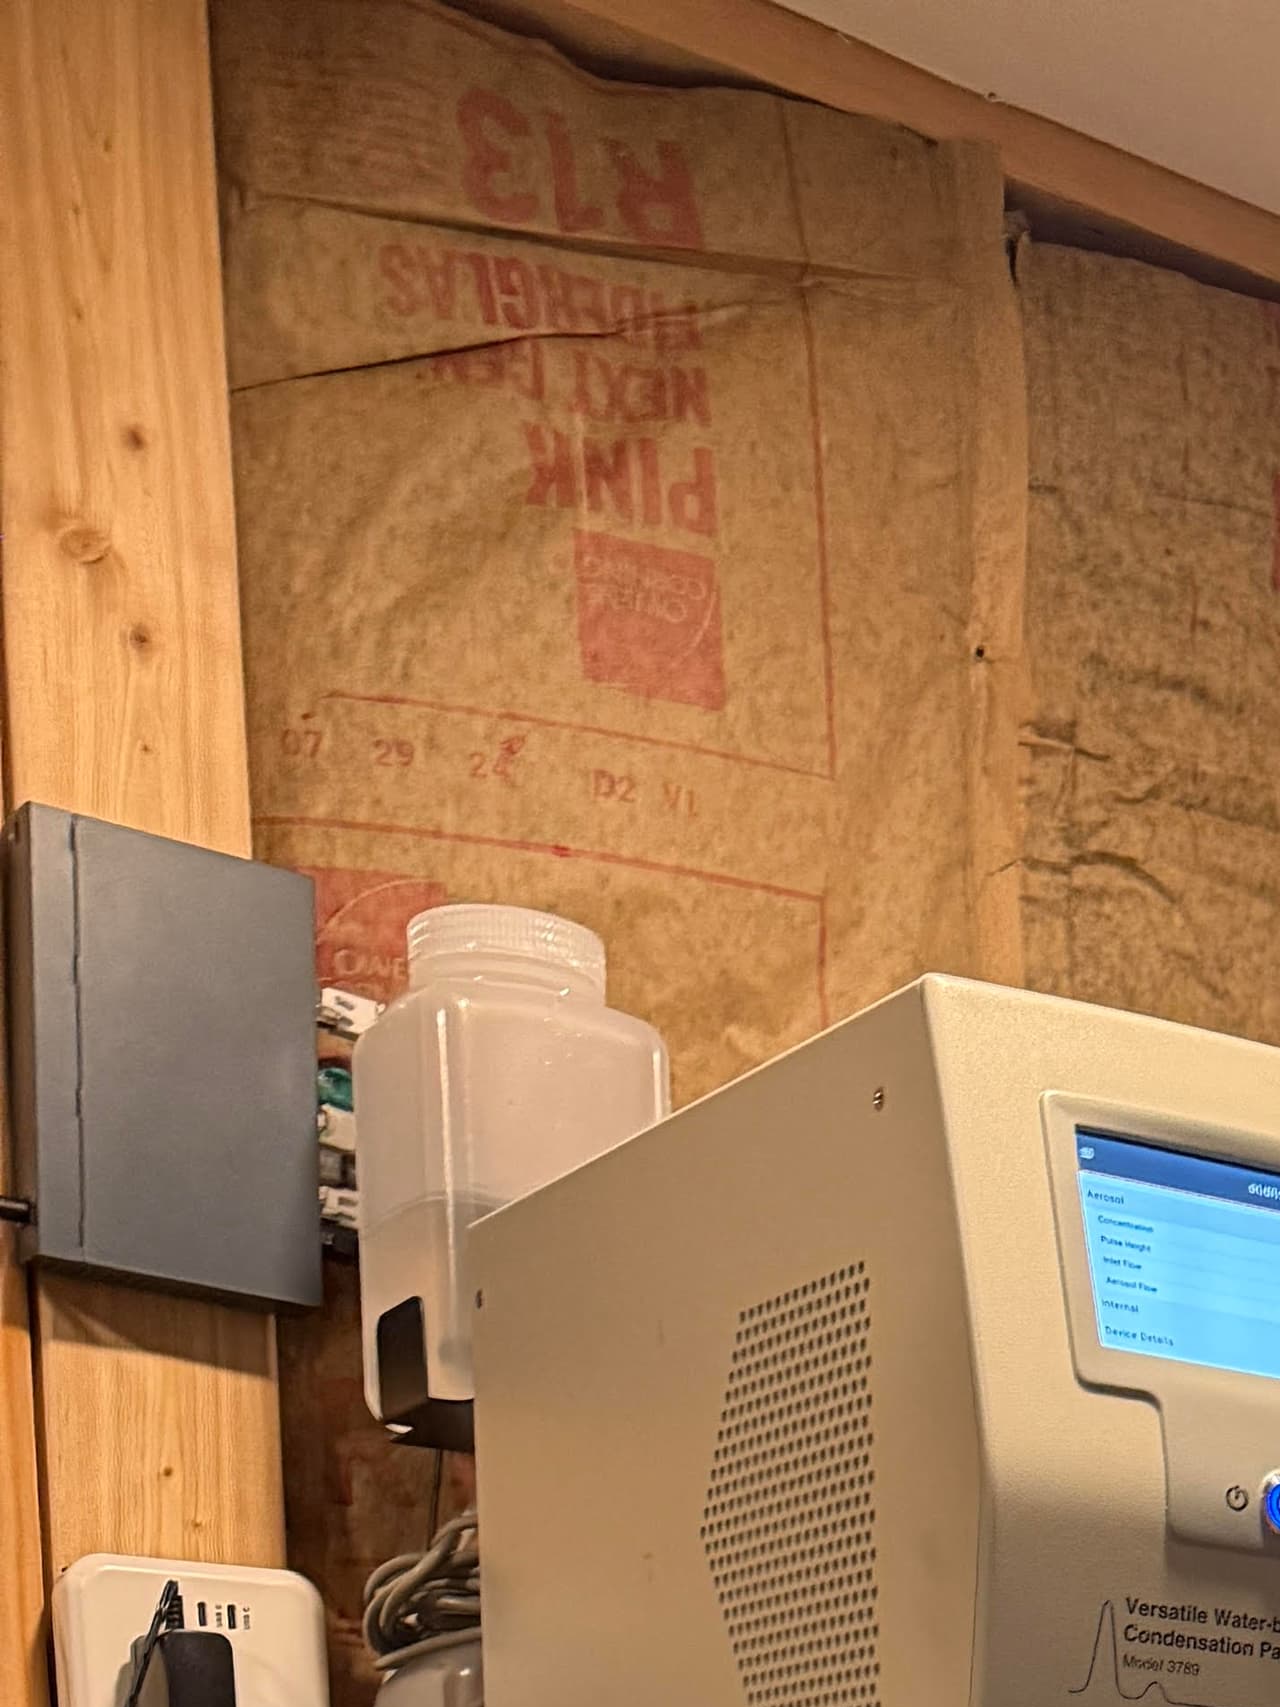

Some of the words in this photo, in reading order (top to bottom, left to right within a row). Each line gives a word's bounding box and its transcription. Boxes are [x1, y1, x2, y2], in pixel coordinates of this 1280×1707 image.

[456, 87, 703, 253] R13
[568, 350, 711, 428] NEXT
[525, 424, 716, 538] PINK
[373, 738, 415, 767] 29
[1087, 1189, 1125, 1205] Aerosol
[1101, 1235, 1123, 1250] Pulse
[1103, 1256, 1121, 1268] Inlet
[1123, 1259, 1142, 1272] Flow
[1106, 1276, 1137, 1290] Aerosol
[1138, 1280, 1158, 1294] Flow
[1102, 1299, 1139, 1313] Internal
[1105, 1325, 1137, 1341] Device
[1141, 1331, 1174, 1347] Details
[1125, 1597, 1207, 1625] Versatile
[1124, 1624, 1254, 1658] Condensation
[1122, 1654, 1164, 1673] Model
